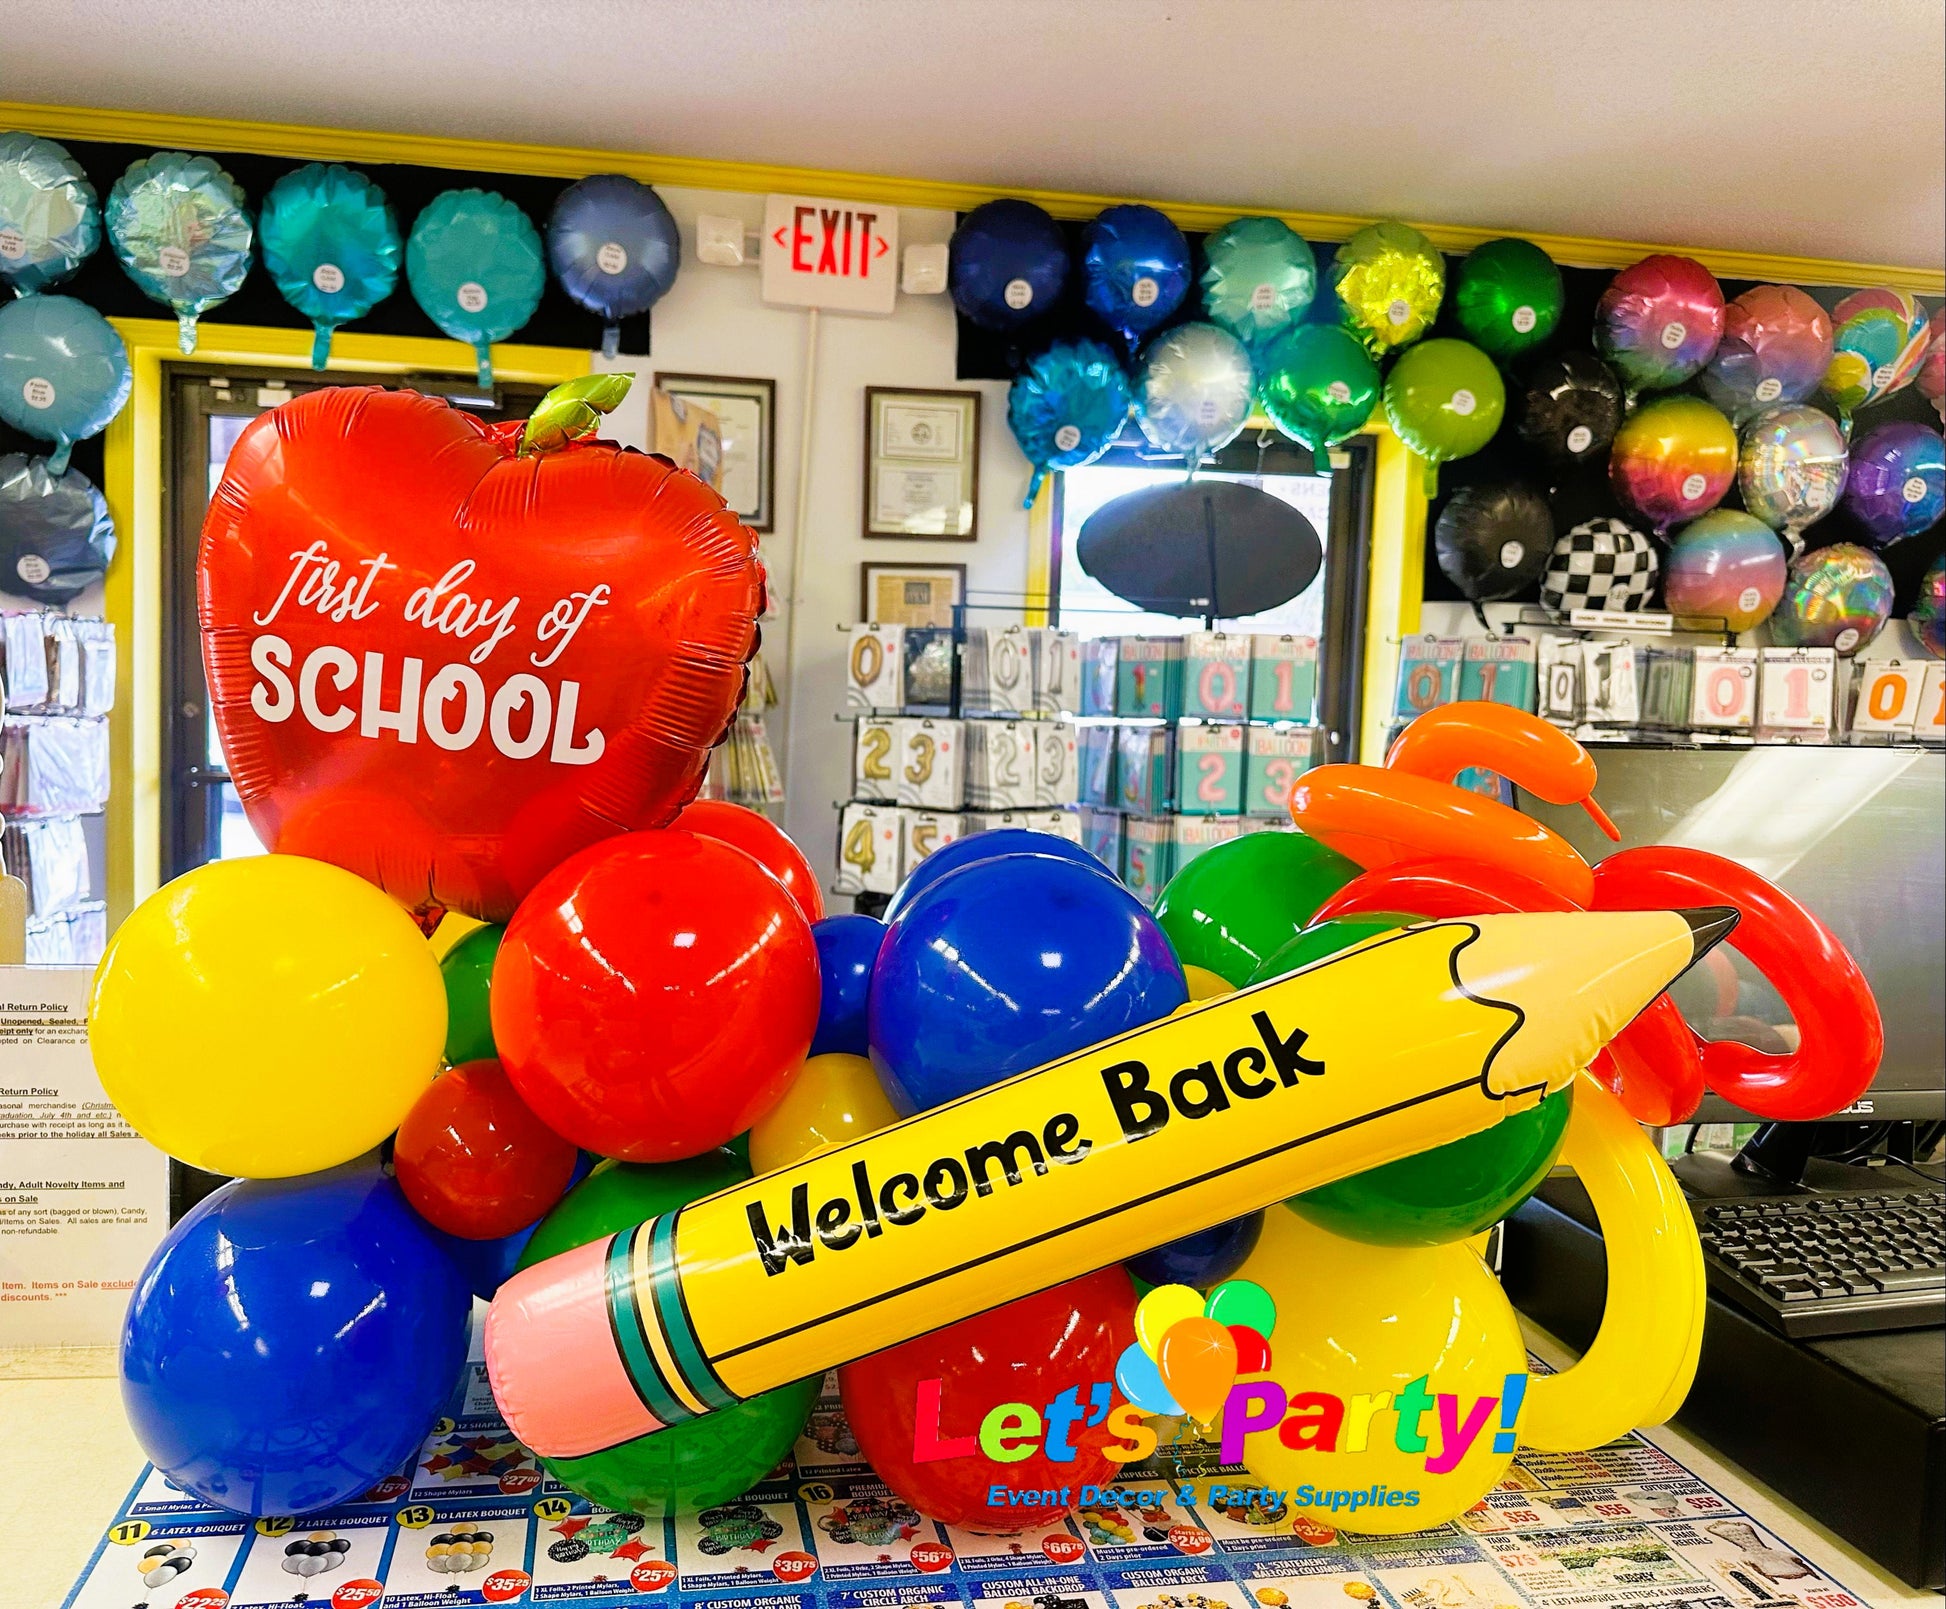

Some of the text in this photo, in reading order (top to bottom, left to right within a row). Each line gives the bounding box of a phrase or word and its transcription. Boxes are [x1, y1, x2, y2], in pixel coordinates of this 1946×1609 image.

[792, 206, 877, 278] EXIT
[253, 540, 611, 667] first day of
[1706, 667, 1745, 718] 0
[1784, 667, 1811, 719] 1
[1868, 673, 1908, 722] 0
[250, 634, 606, 766] SCHOOL
[7, 1003, 68, 1012] Return Policy
[16, 1028, 33, 1036] only
[31, 1088, 58, 1096] Policy
[89, 1122, 104, 1130] long
[66, 1131, 95, 1139] holiday
[745, 1010, 1326, 1277] Welcome Back
[45, 1181, 79, 1190] Novelty
[50, 1208, 80, 1216] (bagged
[121, 1207, 147, 1216] Candy,
[32, 1281, 58, 1289] Items
[77, 1280, 98, 1288] Sale
[1, 1292, 52, 1301] discounts.
[1565, 1487, 1617, 1497] SNOW CONE
[1640, 1483, 1671, 1492] COTTON
[1671, 1481, 1701, 1490] CANDY
[1668, 1486, 1710, 1496] MACHINE
[424, 1490, 446, 1498] Shape
[744, 1492, 789, 1502] BOUQUET
[803, 1485, 828, 1502] 16
[1484, 1494, 1525, 1503] POPCORN
[1579, 1494, 1619, 1503] MACHINE
[538, 1500, 568, 1516] 14
[1492, 1499, 1532, 1509] MACHINE
[1685, 1496, 1724, 1510] $55
[1593, 1503, 1633, 1517] $55
[402, 1507, 527, 1525] 13 10 LATEX BOUQUET
[1502, 1510, 1541, 1523] $55
[262, 1515, 388, 1532] 12 LATEX BOUQUET
[1655, 1522, 1695, 1532] THRONE
[117, 1523, 246, 1540] 11 6 LATEX BOUQUET
[1669, 1530, 1700, 1539] CHAIR
[1484, 1536, 1511, 1545] YARD
[1671, 1536, 1714, 1547] RENTALS
[1126, 1544, 1168, 1554] pre-ordered
[1250, 1544, 1267, 1552] prior
[1421, 1547, 1467, 1558] BALLOON
[1491, 1544, 1520, 1552] SIGNS
[1106, 1553, 1142, 1561] Days prior
[1406, 1557, 1446, 1568] DISPLAY
[1499, 1553, 1538, 1568] $75
[1252, 1564, 1347, 1579] BALLOON COLUMNS
[1254, 1562, 1267, 1570] XL
[1121, 1566, 1209, 1580] CUSTOM ORGANIC
[688, 1582, 707, 1590] Shape
[981, 1575, 1081, 1590] CUSTOM ALL-IN-ONE
[1132, 1574, 1208, 1588] BALLOON ARCH
[572, 1583, 596, 1591] Printed
[613, 1587, 635, 1595] Weight
[853, 1585, 945, 1599] CUSTOM ORGANIC
[983, 1583, 1085, 1598] BALLOON BACKDROP
[1618, 1584, 1717, 1601] LETTERS NUMBERS
[408, 1600, 439, 1608] Balloon
[441, 1597, 472, 1606] Weight
[707, 1594, 802, 1609] CUSTOM ORGANIC
[862, 1594, 929, 1607] CIRCLE ARCH
[1806, 1592, 1858, 1609] $150
